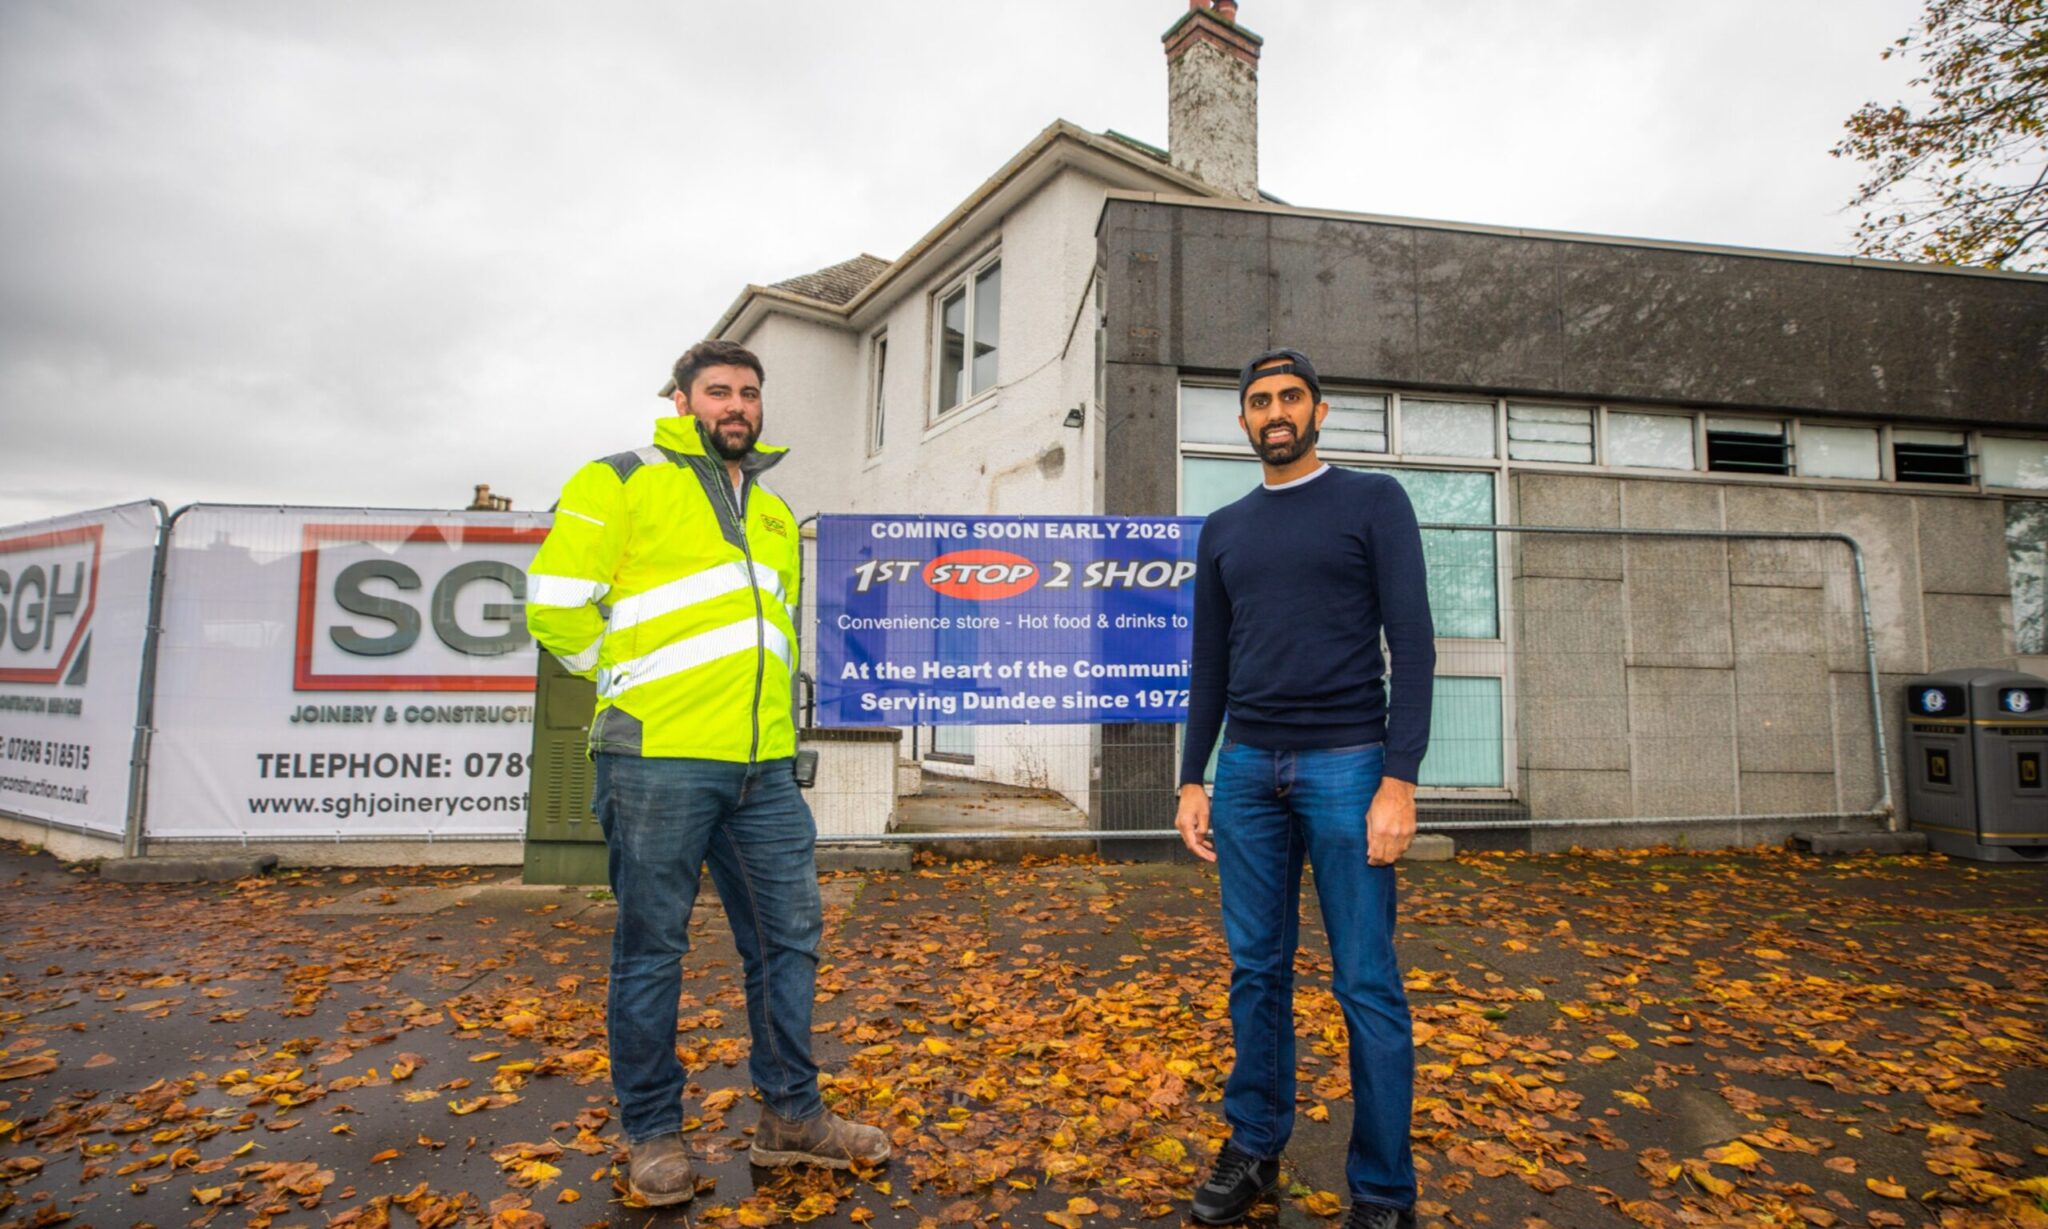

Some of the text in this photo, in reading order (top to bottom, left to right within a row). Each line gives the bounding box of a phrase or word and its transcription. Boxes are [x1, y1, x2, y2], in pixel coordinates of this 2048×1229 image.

[870, 522, 1181, 540] COMING SOON EARLY 2026
[853, 558, 1198, 592] 1ST STOP 2 SHOP
[837, 614, 950, 630] Convenience
[956, 614, 1000, 629] store
[1017, 614, 1048, 629] Hot
[1053, 613, 1091, 629] food
[1096, 613, 1109, 629] &
[1115, 613, 1166, 629] drinks
[1171, 614, 1188, 628] to
[841, 659, 1192, 680] At the Heart of the Communi
[860, 689, 1190, 713] Serving Dundee since 1972
[290, 705, 533, 723] JOINERY & CONSTRUCTI
[7, 737, 42, 764] 07898
[44, 741, 91, 771] 518515
[257, 753, 452, 778] TELEPHONE:
[248, 792, 529, 818] www.sghjoineryconst
